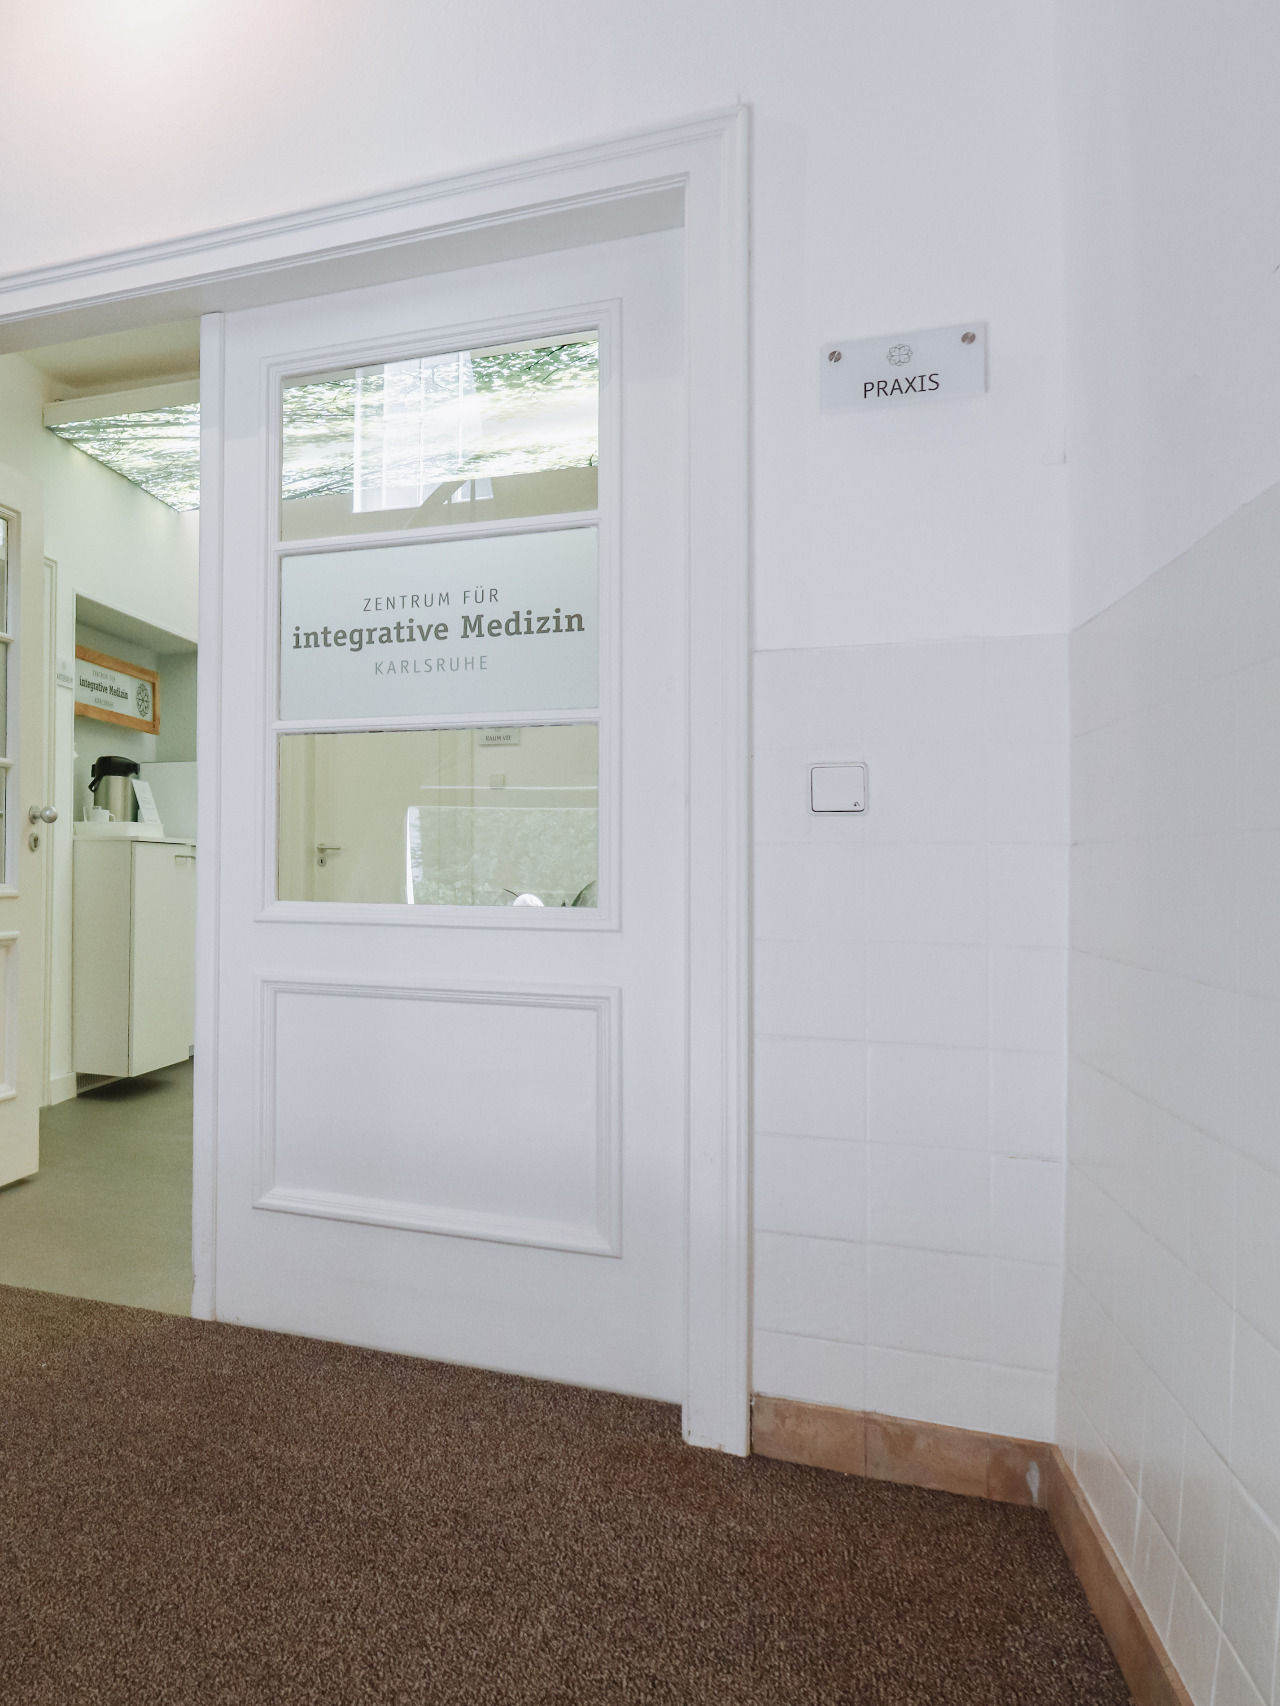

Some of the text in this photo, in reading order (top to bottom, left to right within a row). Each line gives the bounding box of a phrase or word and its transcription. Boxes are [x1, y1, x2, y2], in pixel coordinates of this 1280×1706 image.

[863, 373, 940, 399] PRAXIS
[363, 586, 499, 612] ZENTRUM FÜR
[292, 608, 585, 652] integrative Medizin
[375, 655, 488, 676] KARLSRUHE
[79, 675, 108, 693] integrative
[109, 685, 129, 700] Medizin
